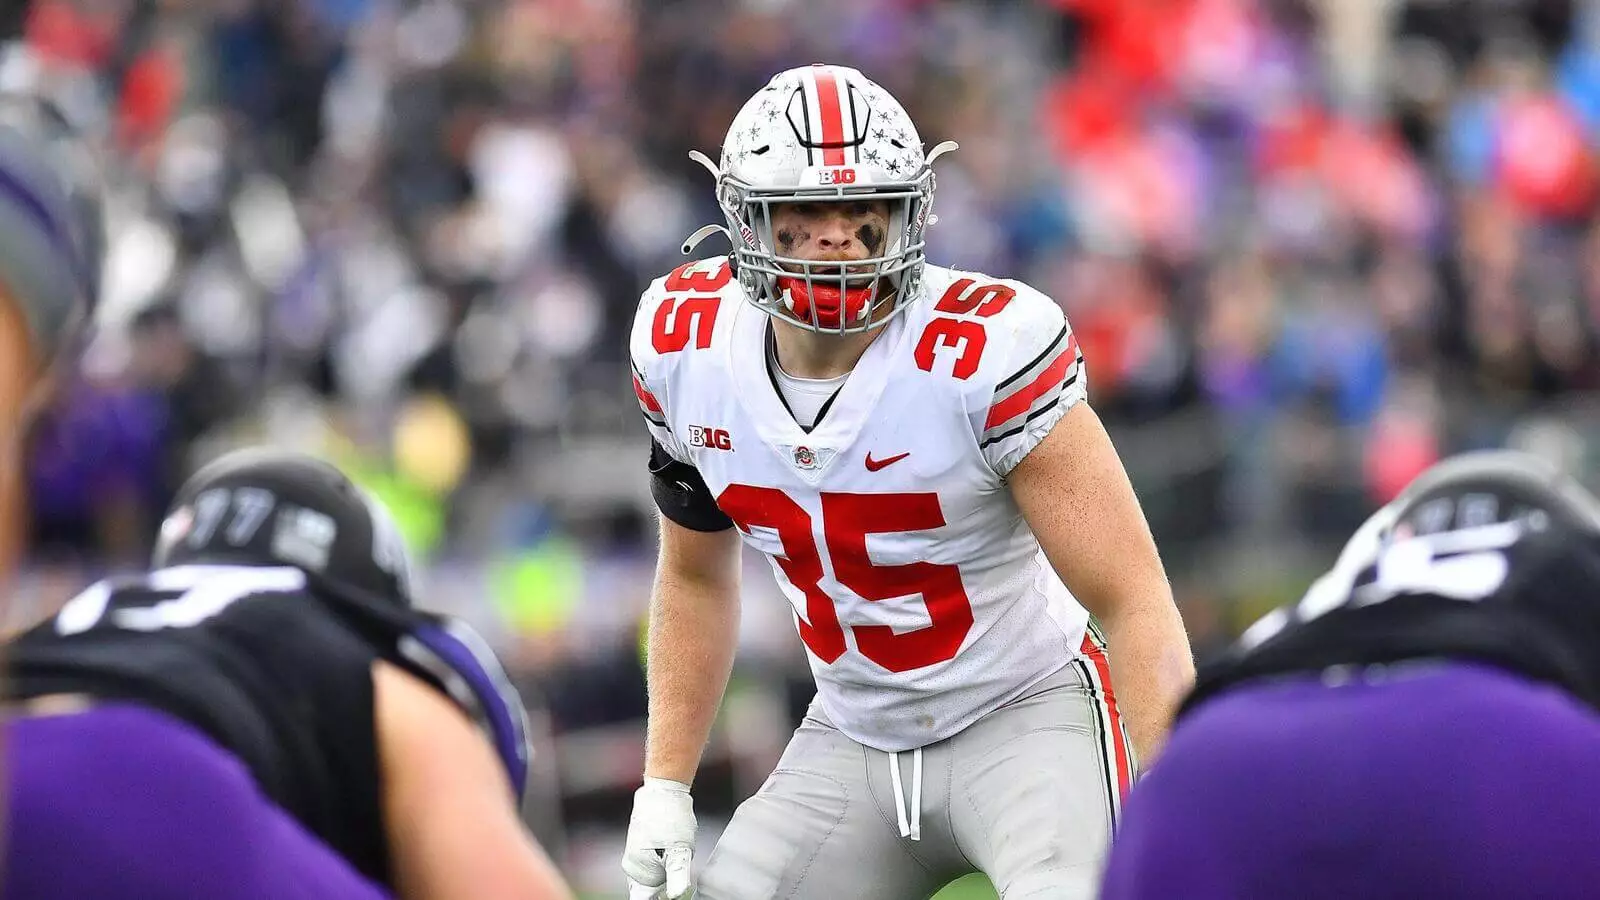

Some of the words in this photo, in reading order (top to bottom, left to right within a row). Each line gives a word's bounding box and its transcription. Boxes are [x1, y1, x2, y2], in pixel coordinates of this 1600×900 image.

[651, 260, 733, 355] 35
[913, 278, 1017, 381] 35
[716, 482, 975, 673] 35
